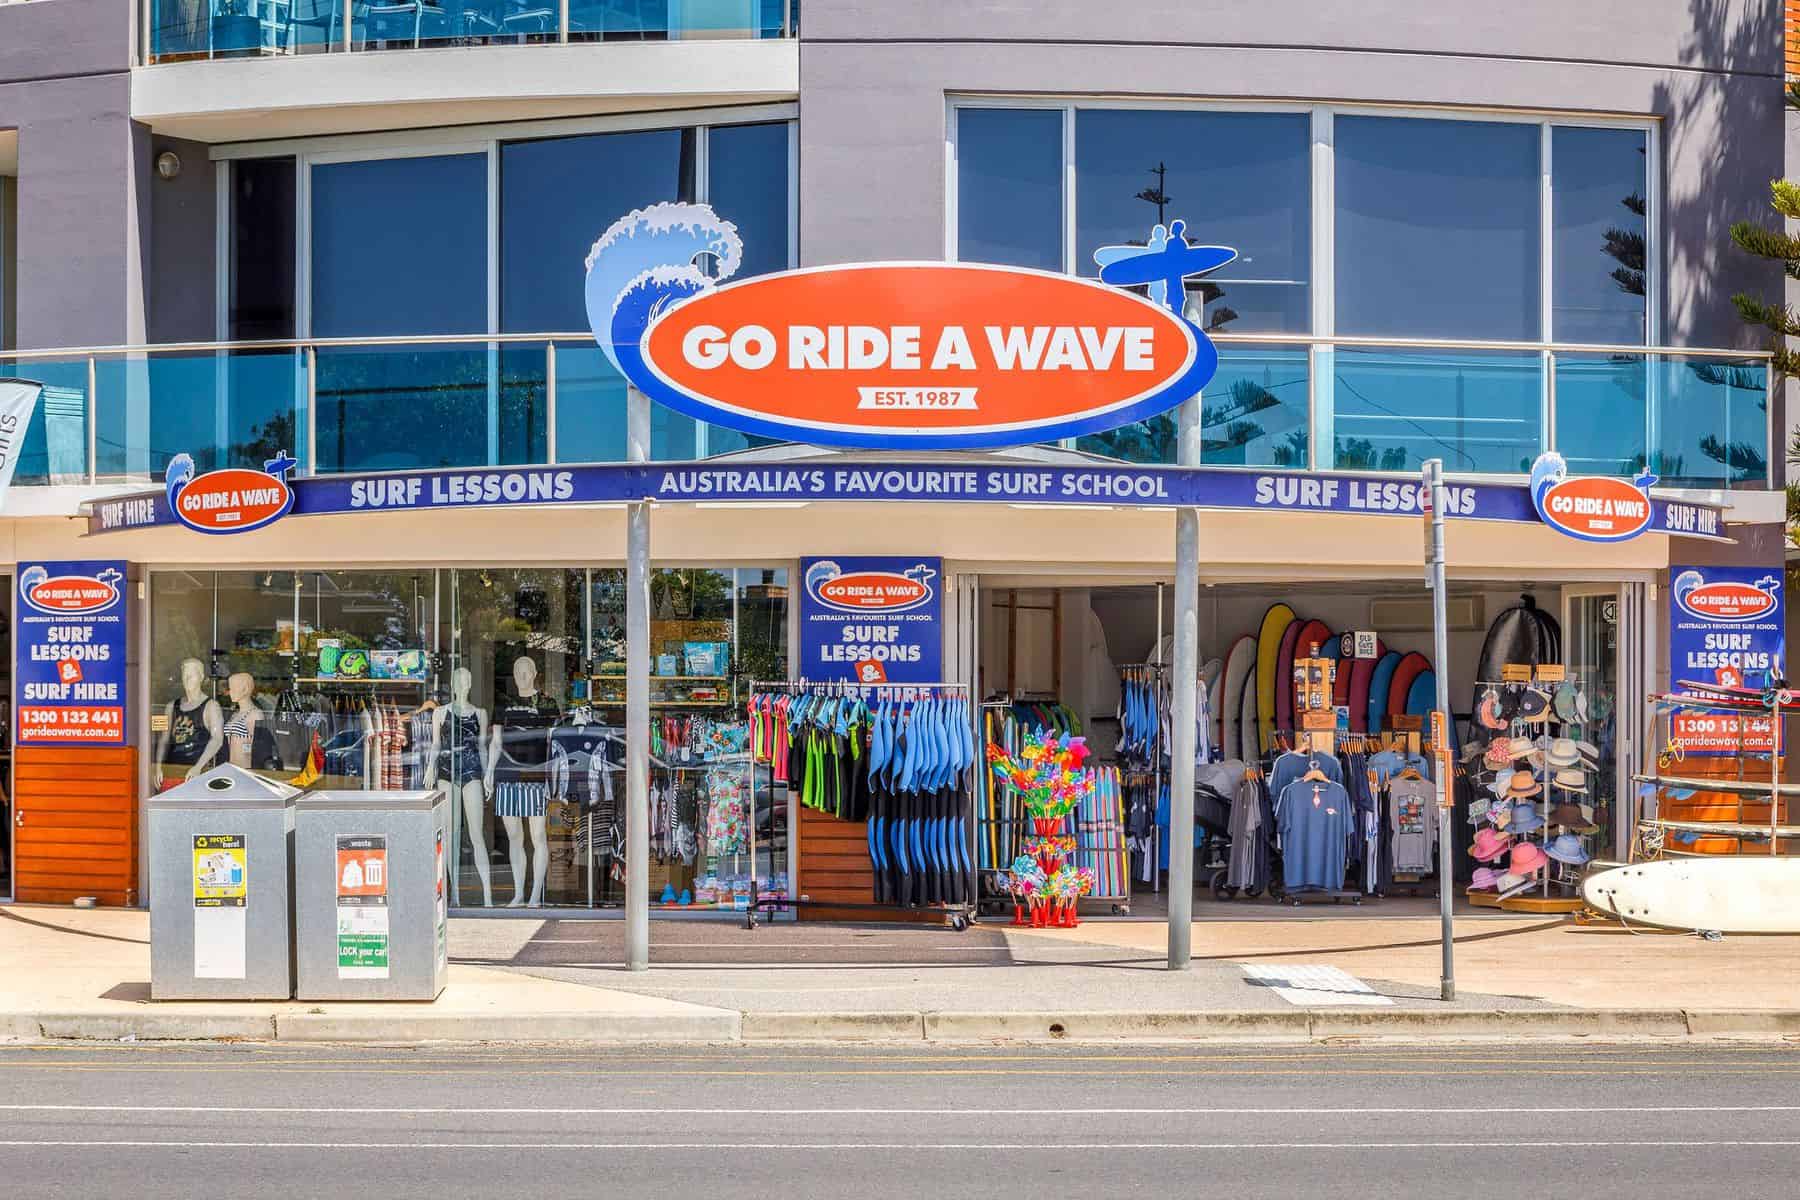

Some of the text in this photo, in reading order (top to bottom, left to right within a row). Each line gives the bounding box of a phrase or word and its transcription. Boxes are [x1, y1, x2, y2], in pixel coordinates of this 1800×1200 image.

[682, 324, 1155, 371] GO RIDE A WAVE
[874, 391, 961, 406] EST. 1987
[350, 471, 574, 508] SURF LESSONS
[659, 470, 1169, 498] AUSTRALIA'S FAVOURITE SURF SCHOOL
[1255, 476, 1339, 507] SURF
[183, 487, 281, 512] GO RIDE A WAVE
[1551, 496, 1645, 519] GO RIDE A WAVE
[102, 498, 155, 528] SURF HIRE
[1666, 503, 1717, 534] SURF HIRE
[36, 589, 109, 599] GO RIDE A WAVE
[826, 586, 919, 596] GO RIDE A WAVE
[1691, 596, 1768, 606] GO RIDE A WAVE
[47, 626, 93, 642] SURF
[842, 625, 900, 642] SURF
[1704, 633, 1752, 650] SURF
[31, 644, 110, 661] LESSONS
[821, 644, 921, 662] LESSONS
[1687, 651, 1769, 669] LESSONS
[62, 663, 78, 680] &
[862, 664, 882, 682] &
[24, 683, 118, 700] SURF HIRE
[813, 686, 872, 702] RF
[23, 711, 118, 724] 1300 132 441
[1678, 719, 1716, 733] 1300
[1751, 719, 1775, 733] 44
[22, 725, 120, 740] gorideawave.com.au
[339, 946, 357, 956] LOCK
